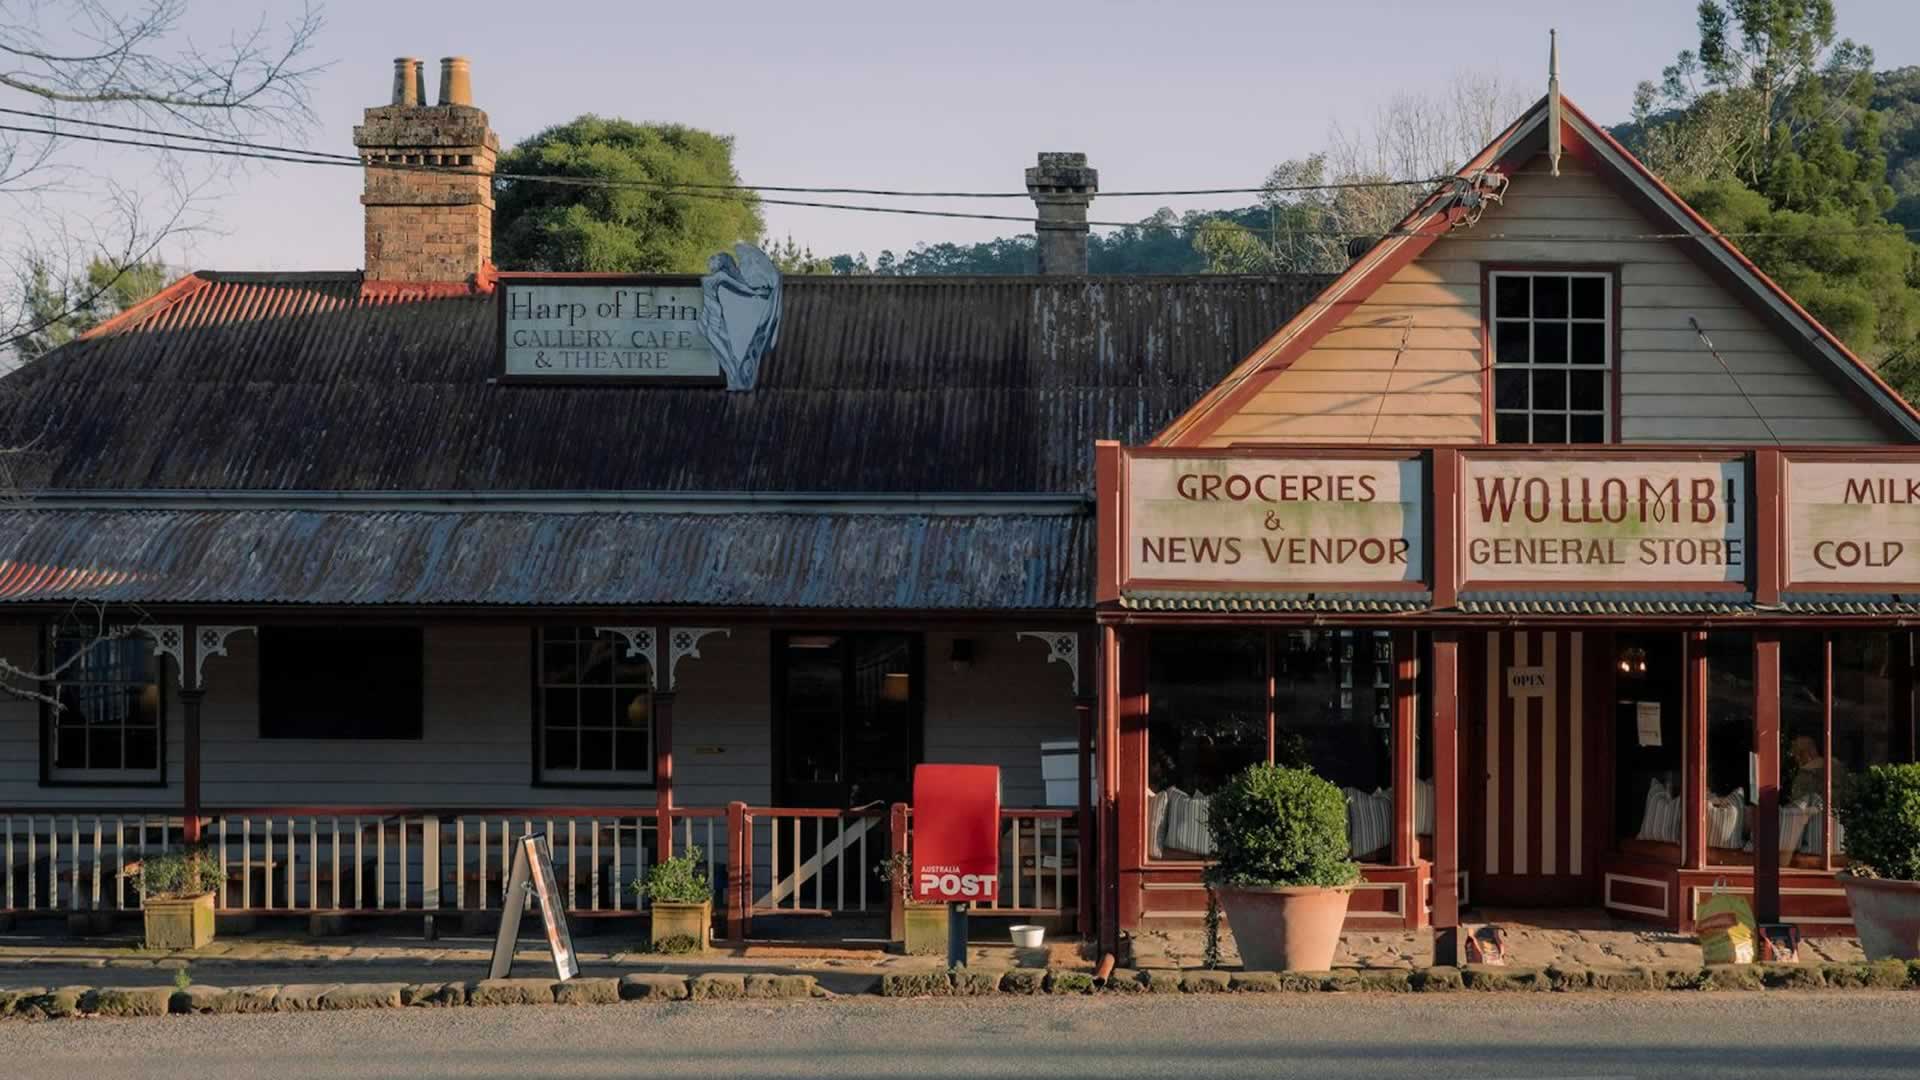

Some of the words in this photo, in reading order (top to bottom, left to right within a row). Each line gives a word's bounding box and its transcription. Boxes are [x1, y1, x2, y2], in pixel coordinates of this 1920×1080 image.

[509, 290, 587, 326] Harp
[597, 290, 628, 319] of
[635, 291, 699, 320] Erin
[631, 330, 693, 349] CAFE
[535, 351, 553, 369] &
[559, 351, 670, 369] THEATRE
[1177, 474, 1377, 502] GROCERIES
[1474, 477, 1737, 524] WOLLOMBI
[1264, 510, 1284, 531] &
[1142, 536, 1242, 564] NEWS
[1261, 537, 1410, 565] VENDOR
[1468, 538, 1626, 565] GENERAL
[1639, 538, 1742, 566] STORE
[1813, 540, 1904, 570] COLD
[1513, 674, 1545, 686] OPEN
[921, 866, 960, 874] AUSTRALIA
[920, 874, 997, 896] POST
